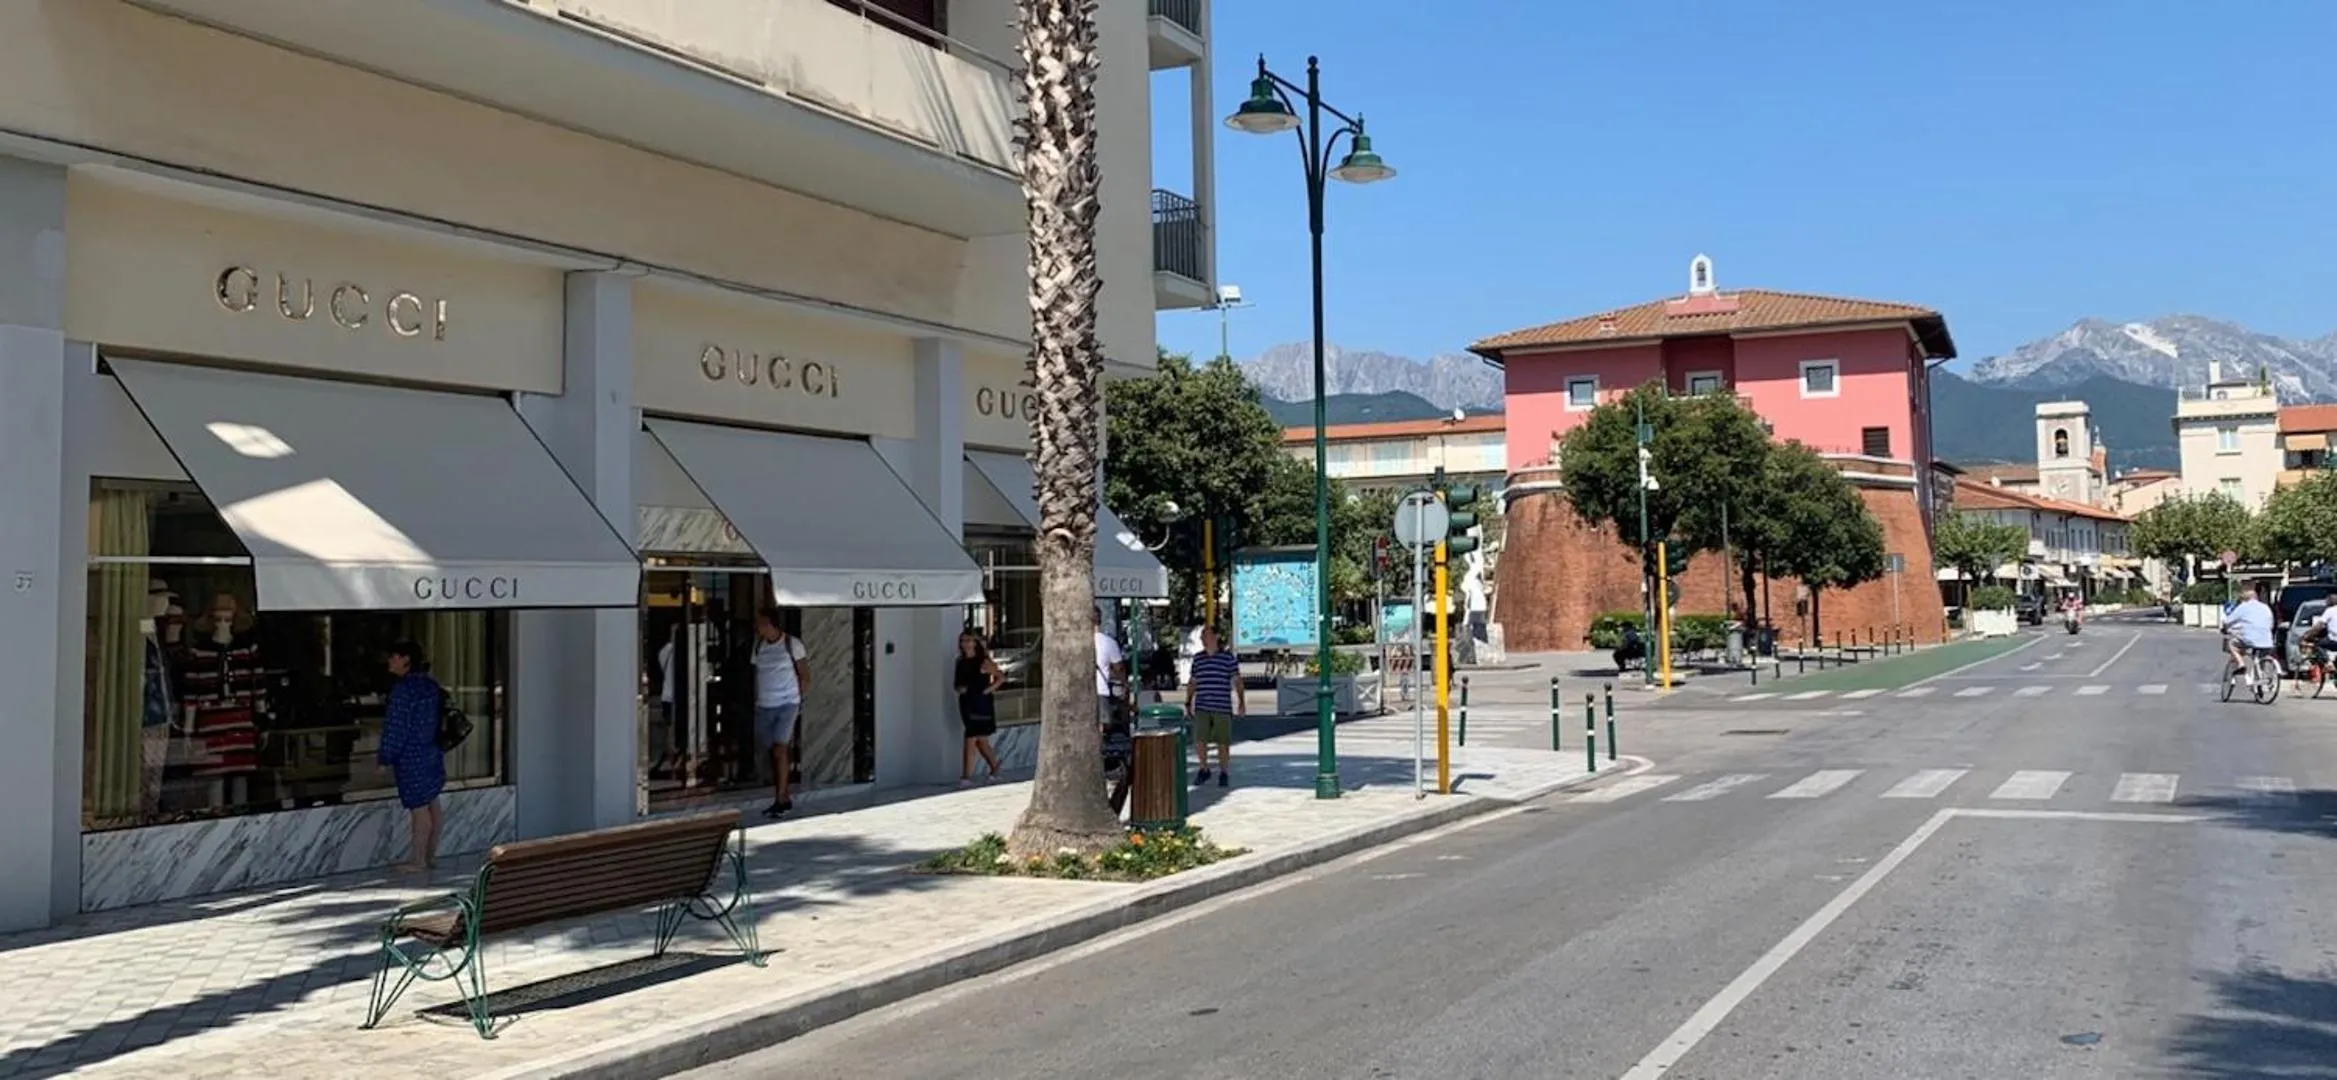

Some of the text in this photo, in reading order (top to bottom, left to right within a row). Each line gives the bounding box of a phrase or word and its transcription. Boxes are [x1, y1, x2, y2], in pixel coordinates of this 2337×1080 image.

[215, 265, 447, 341] GUCCI
[701, 345, 838, 398] GUCCI
[976, 387, 1038, 422] GUC
[414, 576, 518, 600] GUCCI
[853, 581, 916, 600] GUCCI
[1099, 577, 1143, 593] GUCCI
